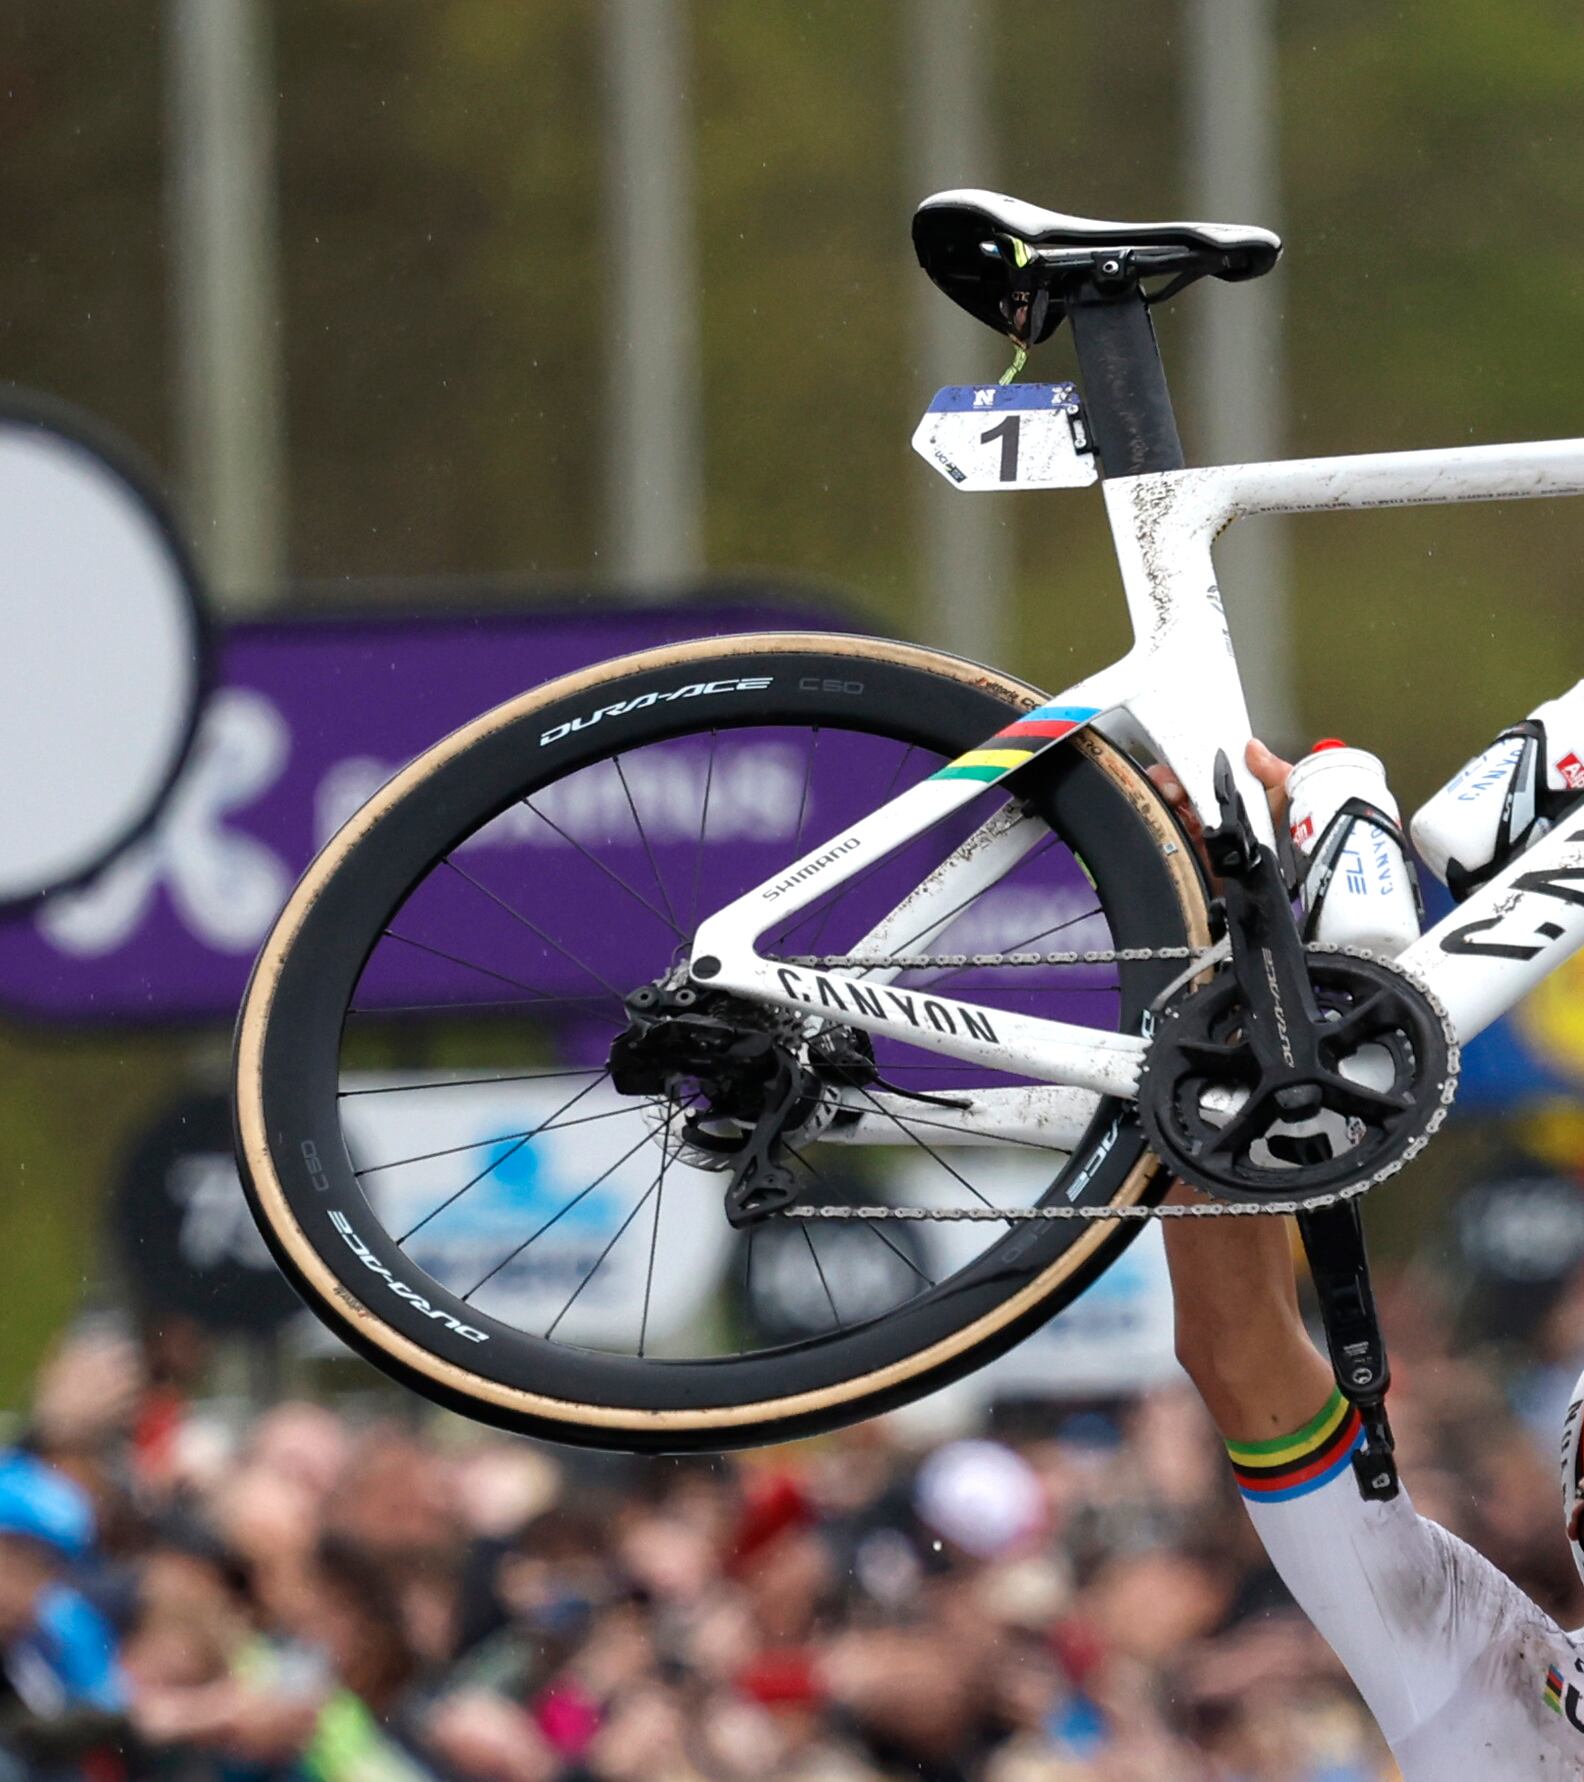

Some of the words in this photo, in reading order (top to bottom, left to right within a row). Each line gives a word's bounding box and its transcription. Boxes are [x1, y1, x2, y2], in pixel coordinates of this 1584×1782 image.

[980, 415, 1020, 482] 1
[539, 676, 774, 747] DURA-ACE
[762, 837, 862, 902] SHIMANO
[1370, 828, 1395, 896] CANYO
[777, 967, 1000, 1044] CANYON
[1261, 947, 1295, 1069] DURA-ACE
[326, 1209, 490, 1344] DURA-ACE
